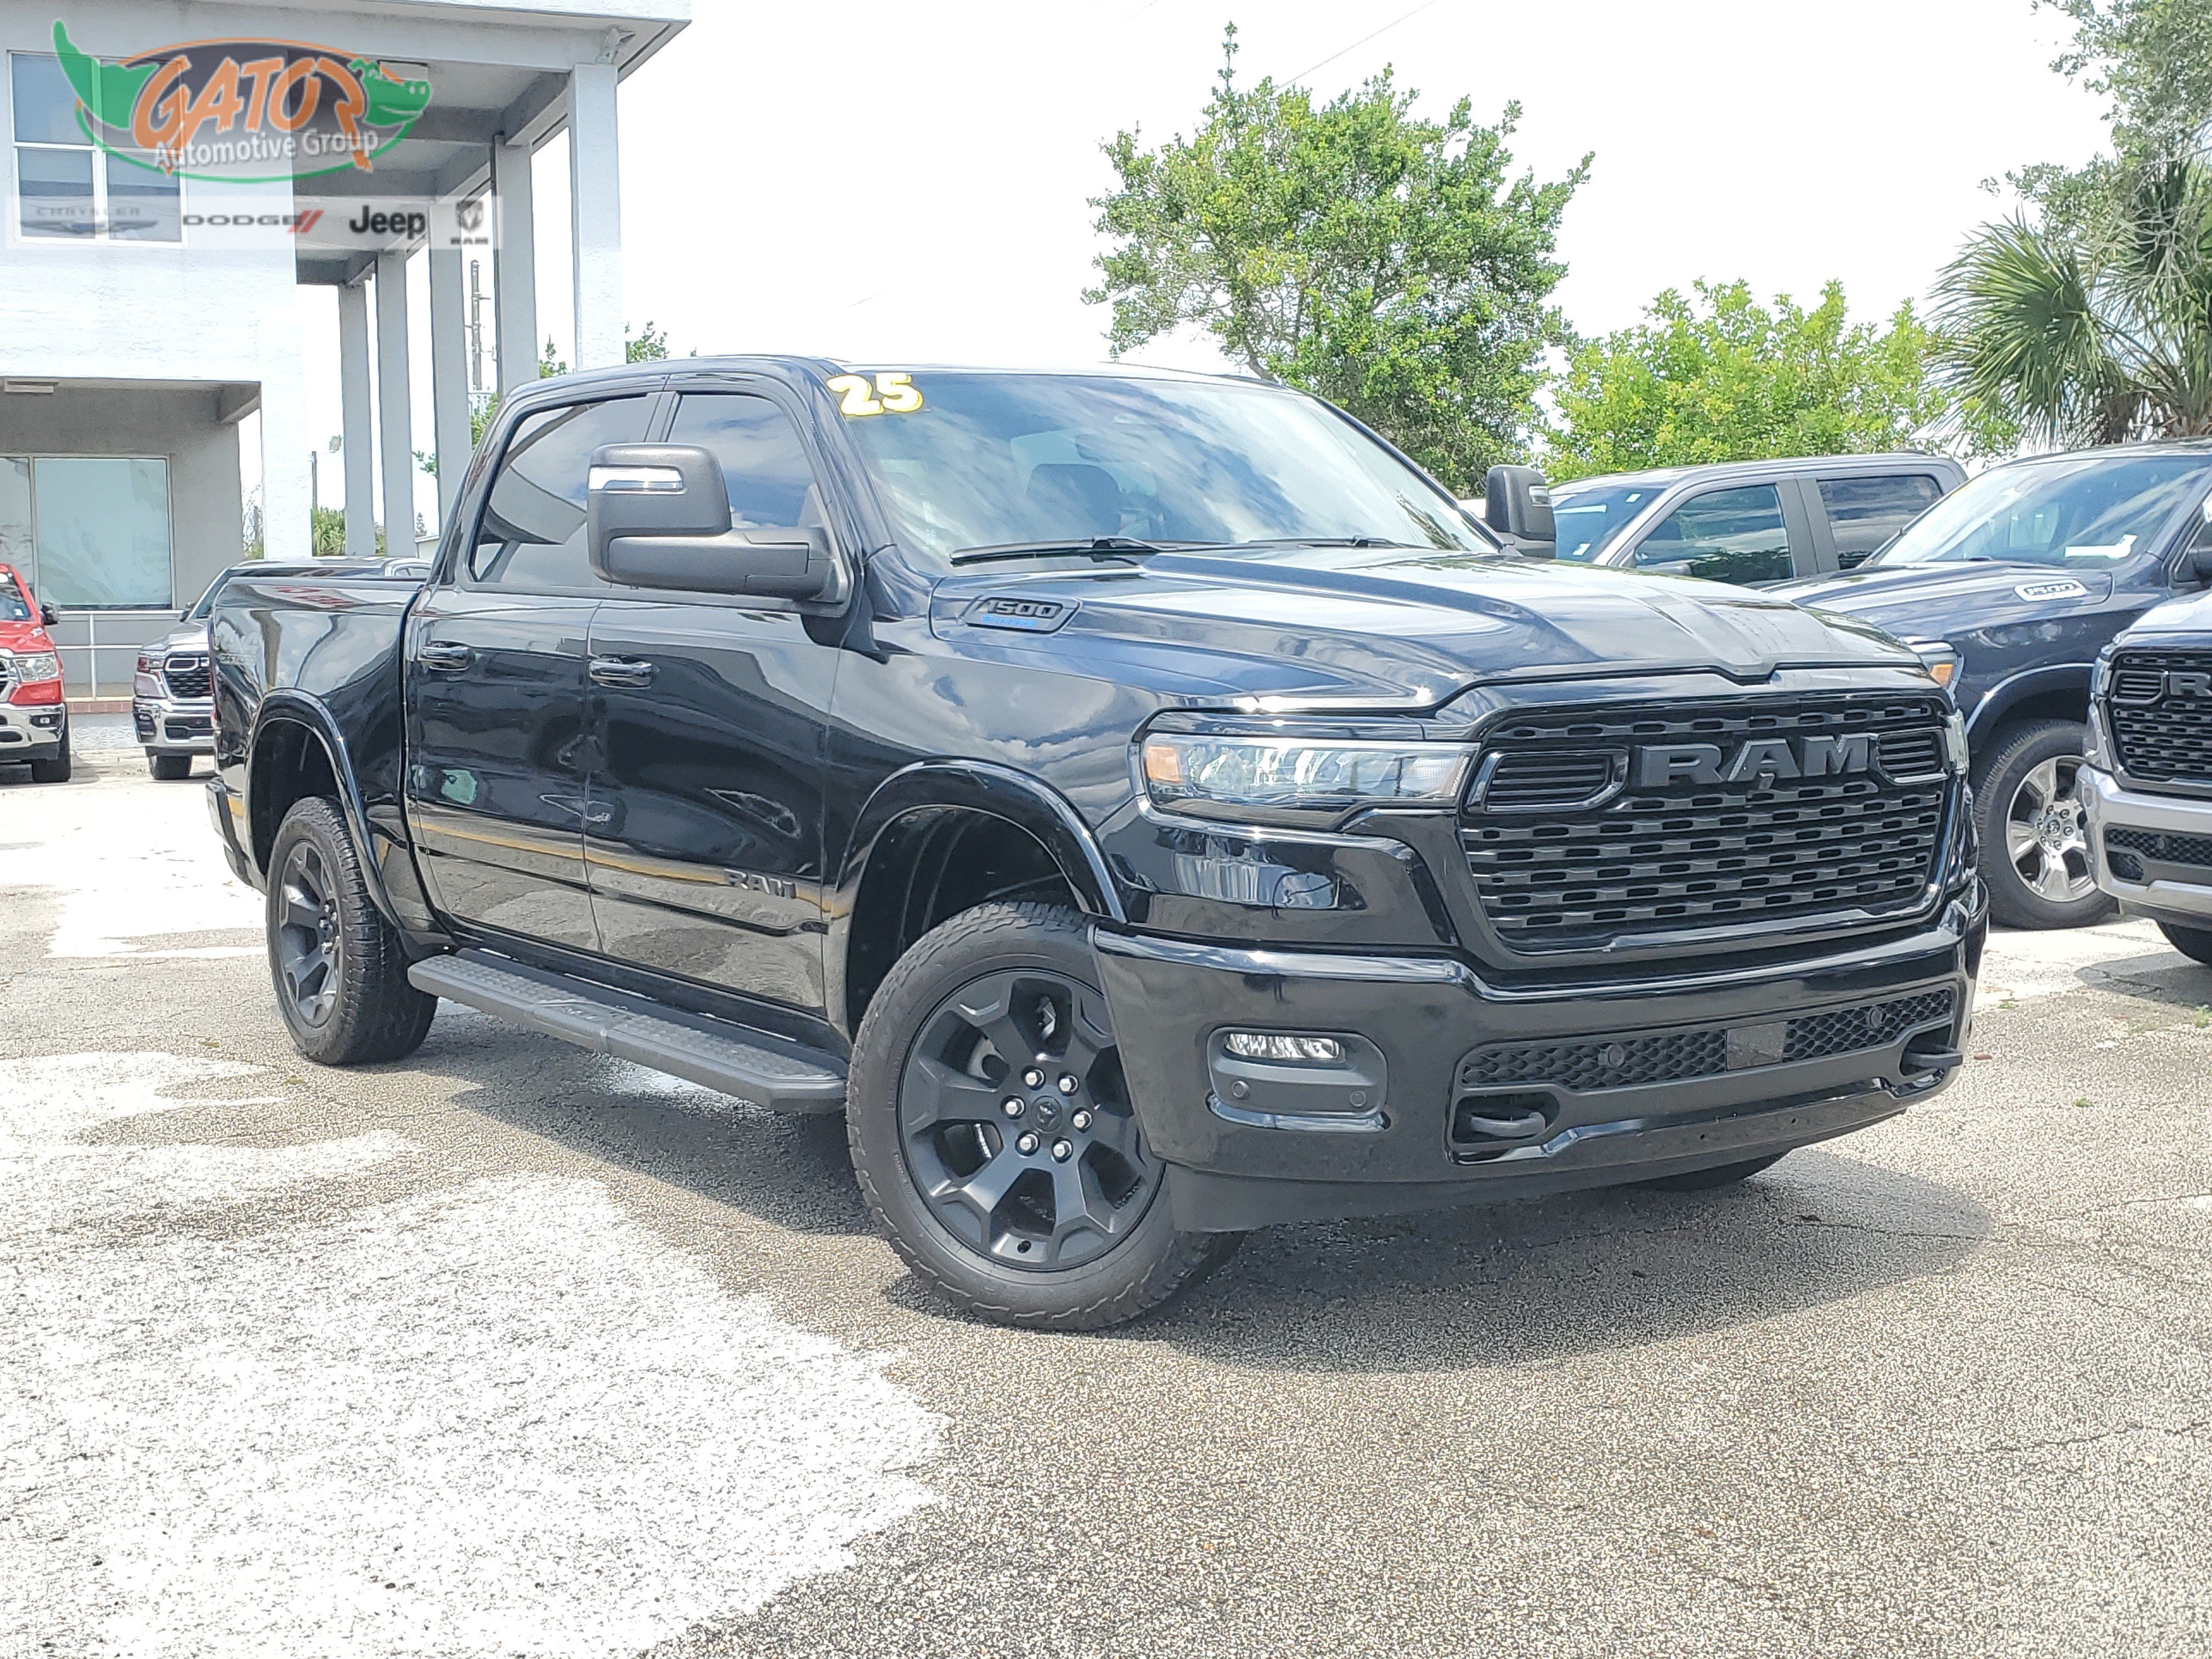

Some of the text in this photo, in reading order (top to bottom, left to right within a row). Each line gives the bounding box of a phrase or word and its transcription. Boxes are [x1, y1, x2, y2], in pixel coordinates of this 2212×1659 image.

[826, 372, 924, 416] 25
[2024, 583, 2075, 596] 1500
[986, 599, 1060, 619] 1500
[1640, 733, 1870, 787] RAM
[724, 868, 797, 899] RAM
